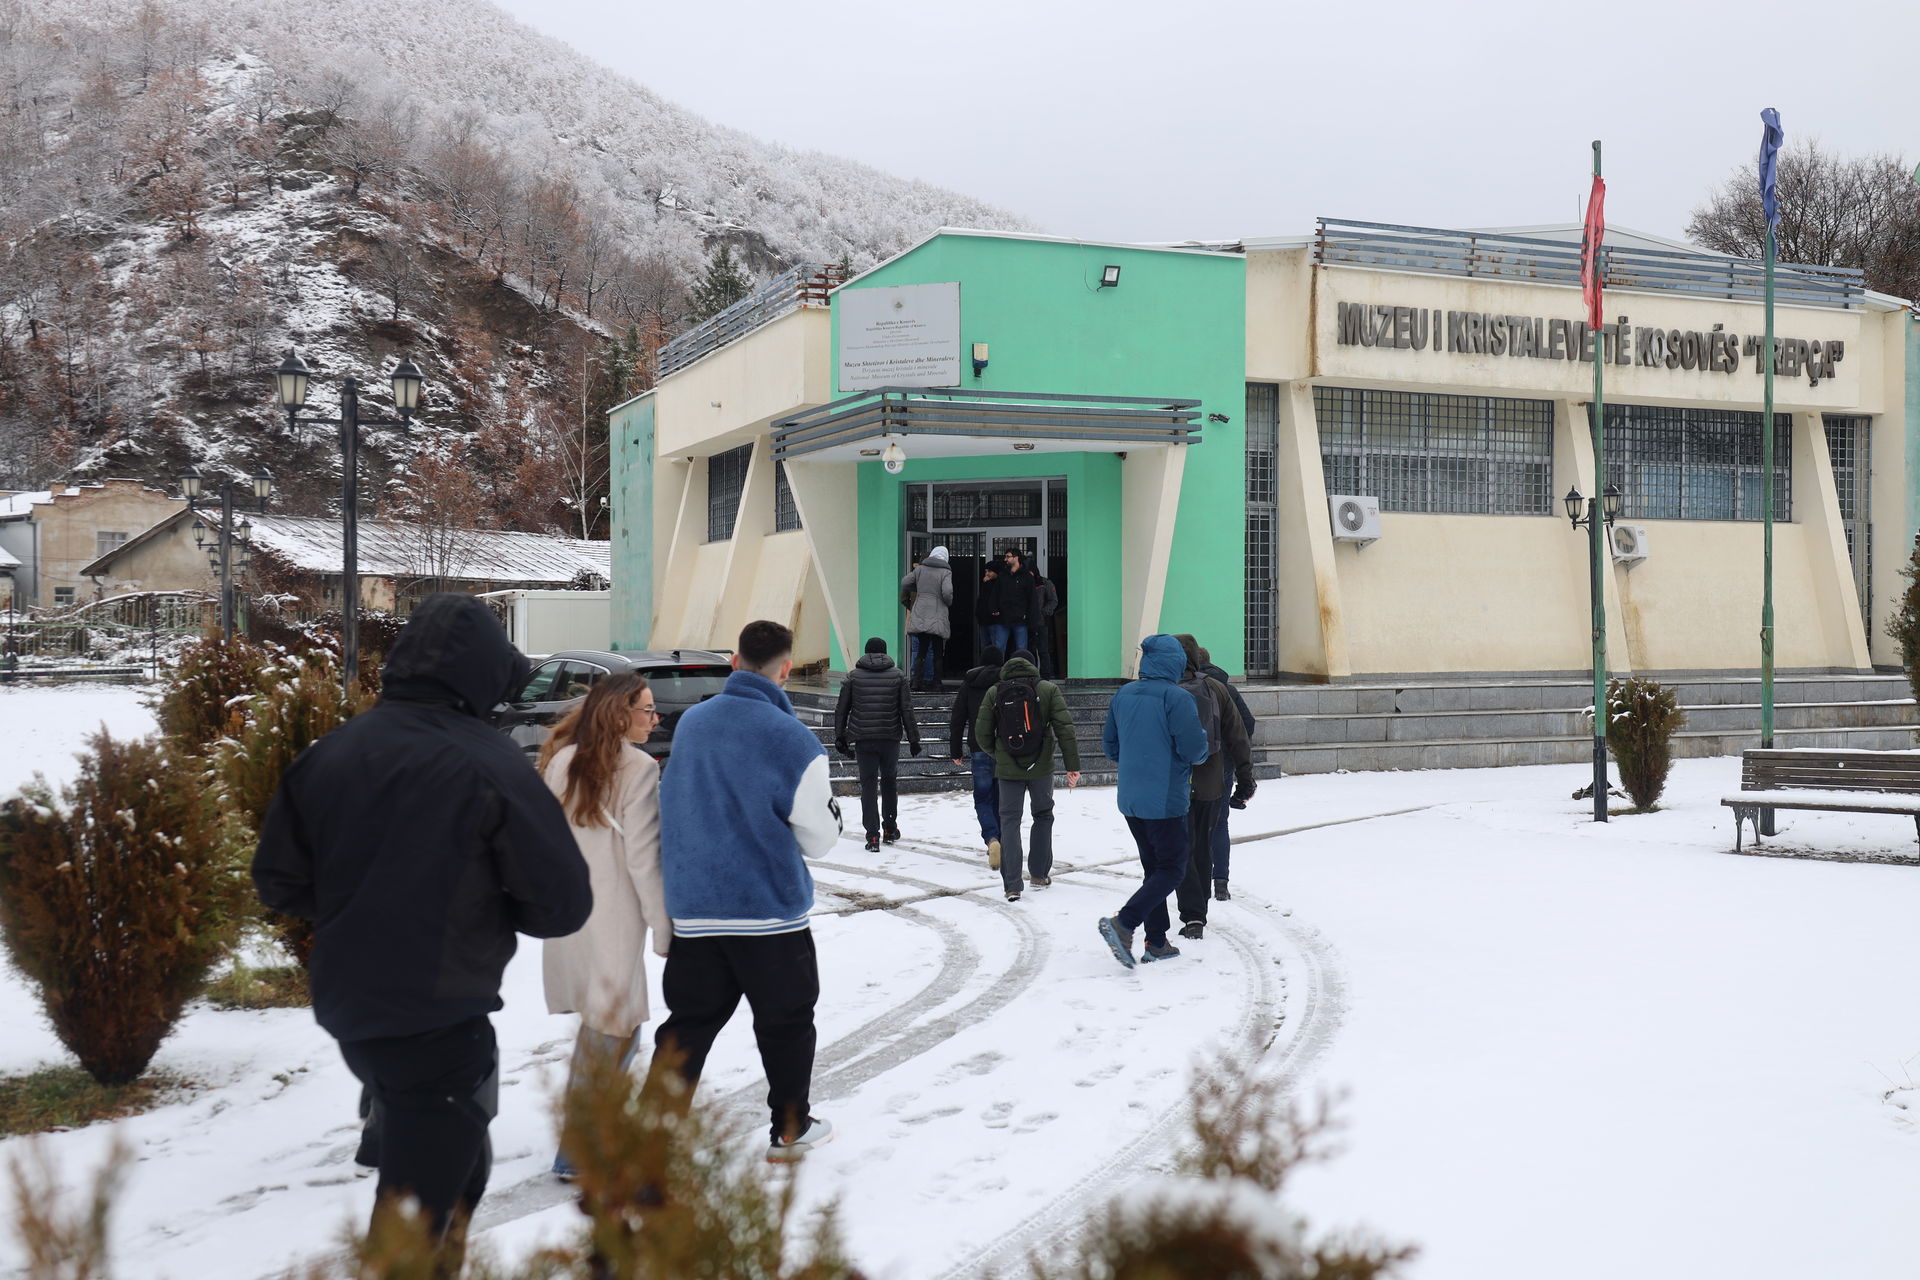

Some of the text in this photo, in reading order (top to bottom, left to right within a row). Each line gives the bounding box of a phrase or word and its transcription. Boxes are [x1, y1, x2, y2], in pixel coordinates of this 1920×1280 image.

[1337, 301, 1429, 350] MUZEU
[1433, 309, 1442, 351] I
[1447, 310, 1595, 362] KRISTALEVE
[1635, 323, 1739, 375] KOSOVËS
